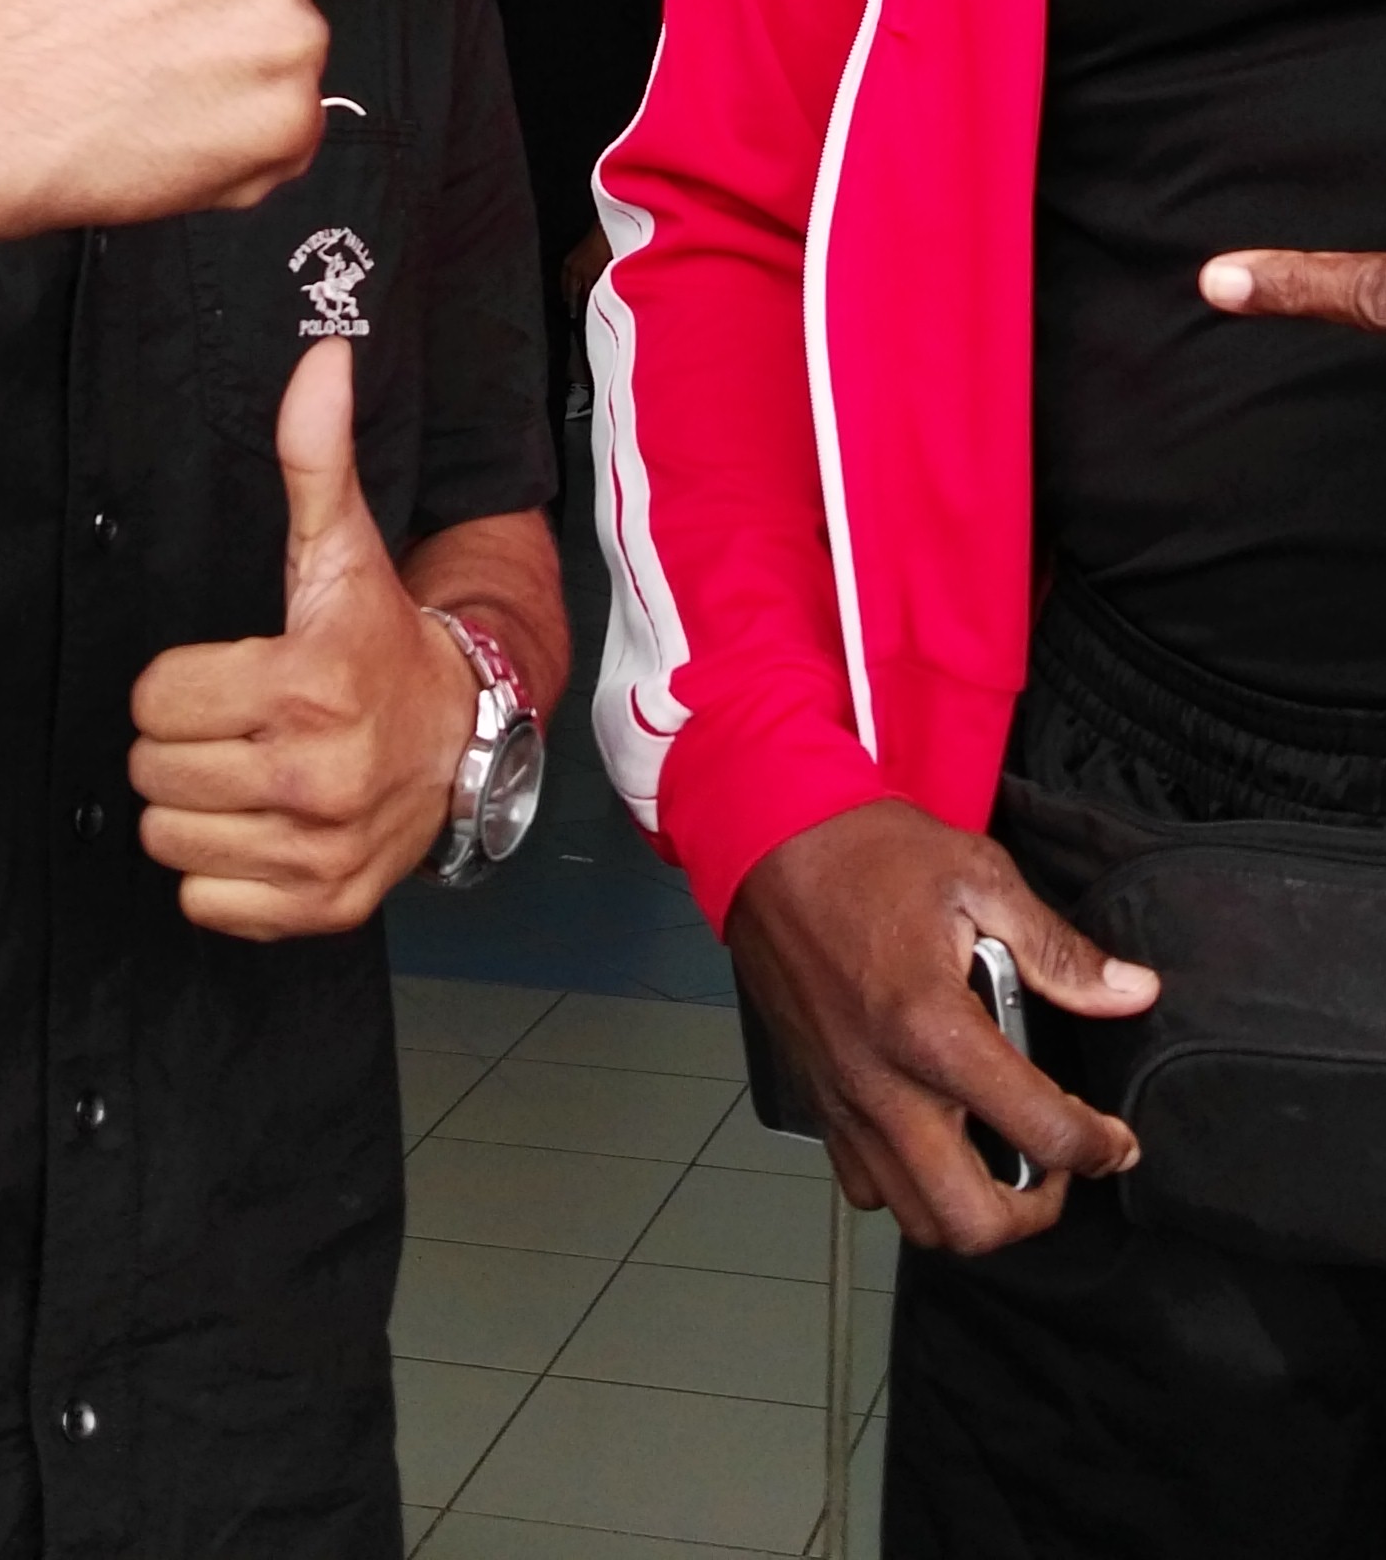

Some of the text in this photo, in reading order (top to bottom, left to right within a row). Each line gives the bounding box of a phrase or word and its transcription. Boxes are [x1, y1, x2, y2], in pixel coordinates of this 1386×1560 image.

[344, 232, 375, 271] HILLS
[298, 319, 370, 337] POLO CLUB
